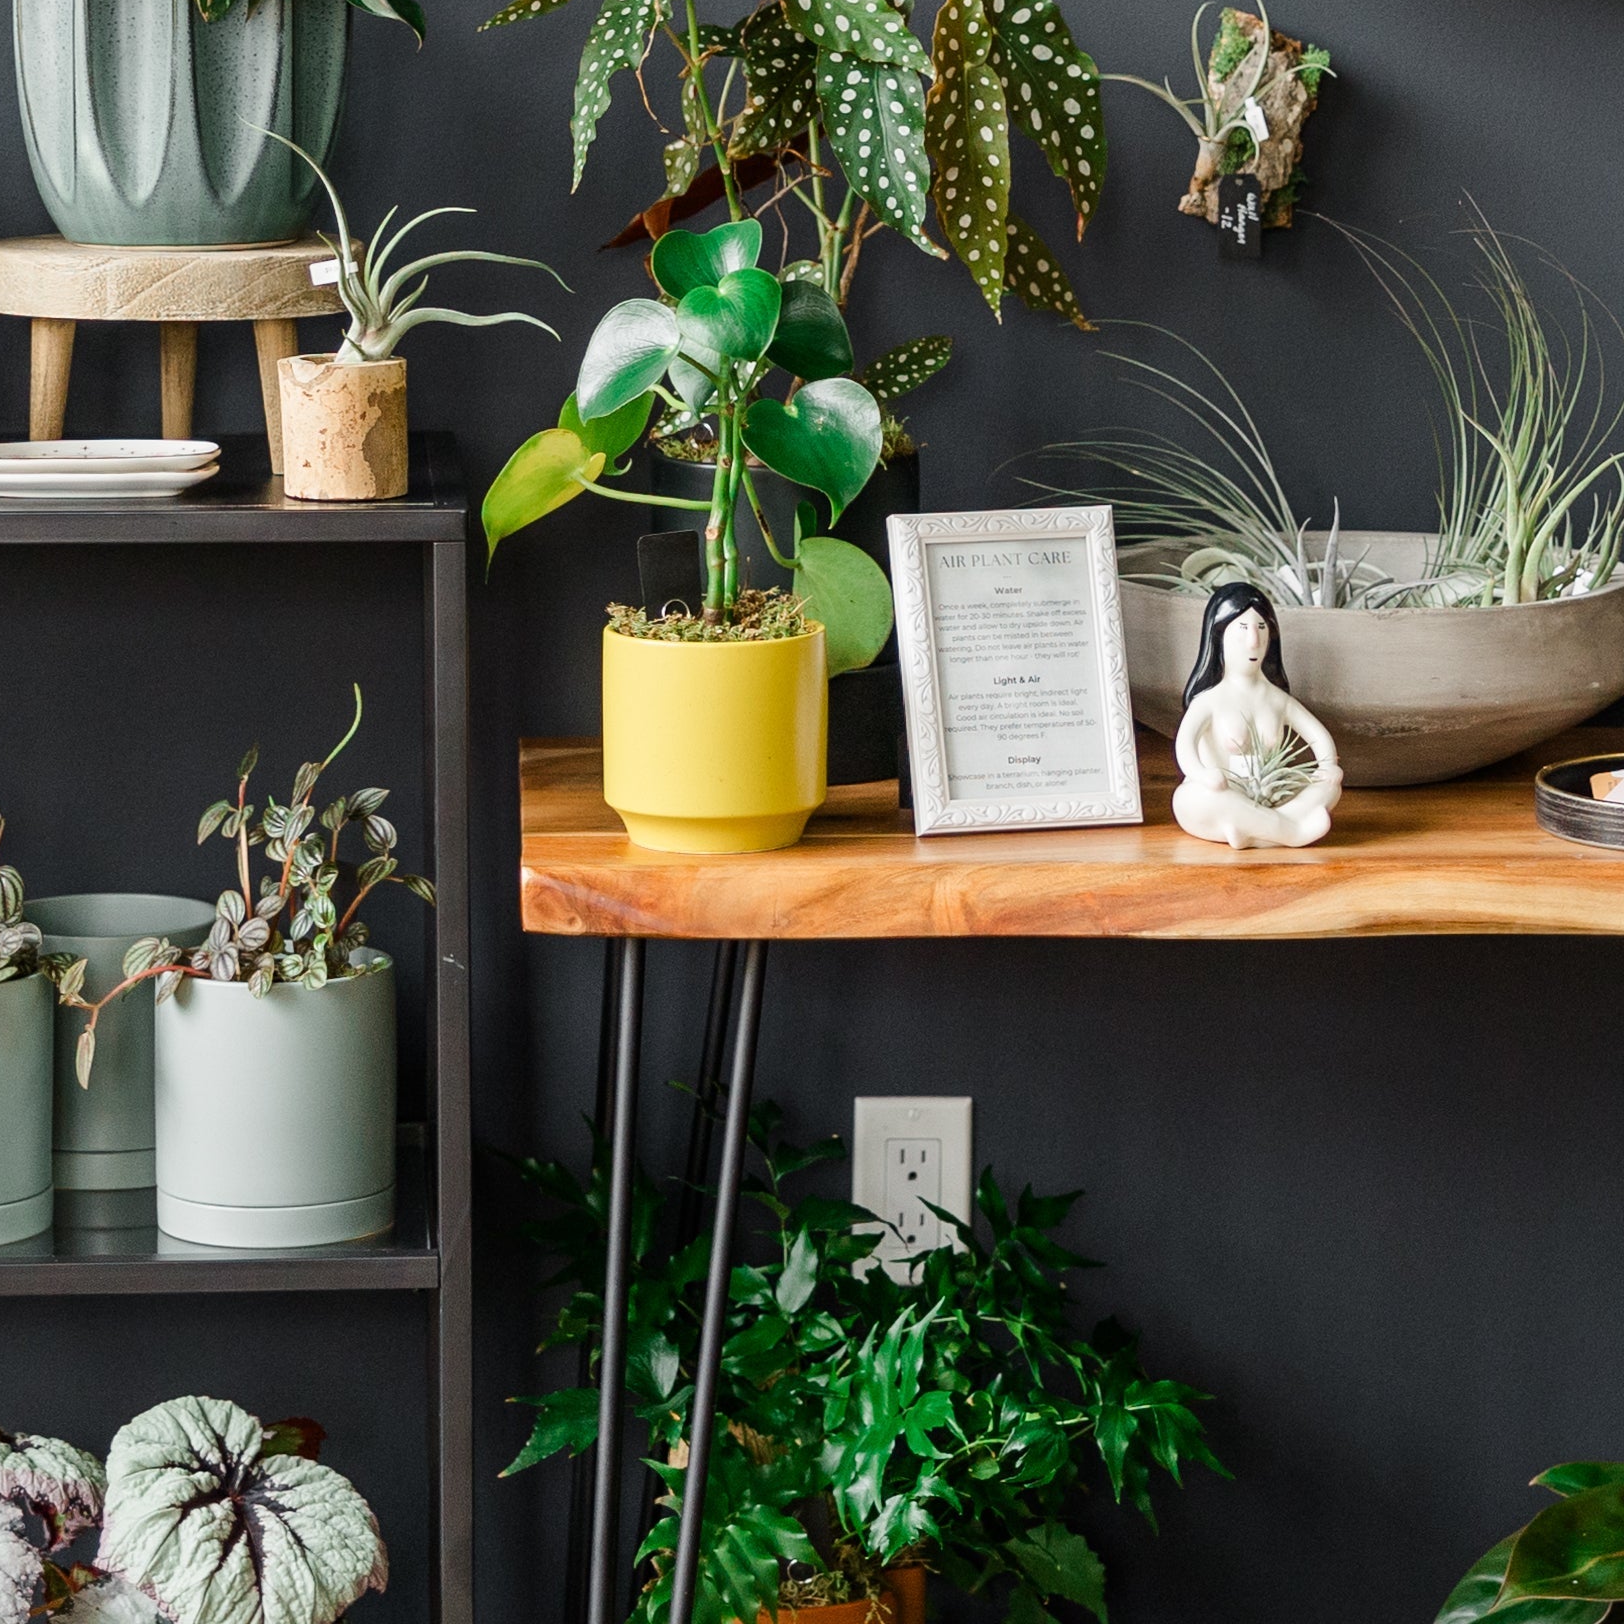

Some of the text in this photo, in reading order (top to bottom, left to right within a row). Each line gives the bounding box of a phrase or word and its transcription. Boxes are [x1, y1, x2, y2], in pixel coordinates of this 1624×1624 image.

[940, 551, 1071, 568] AIR PLANT CARE
[1034, 642, 1057, 650] plants
[1034, 652, 1050, 660] they
[994, 676, 1017, 686] Light
[1028, 675, 1040, 683] Air
[961, 693, 984, 701] plants
[1071, 688, 1088, 696] light
[1004, 701, 1027, 709] bright
[989, 712, 1029, 720] circulation
[1009, 733, 1039, 741] degrees
[1008, 756, 1041, 765] Display
[1041, 769, 1072, 777] hanging
